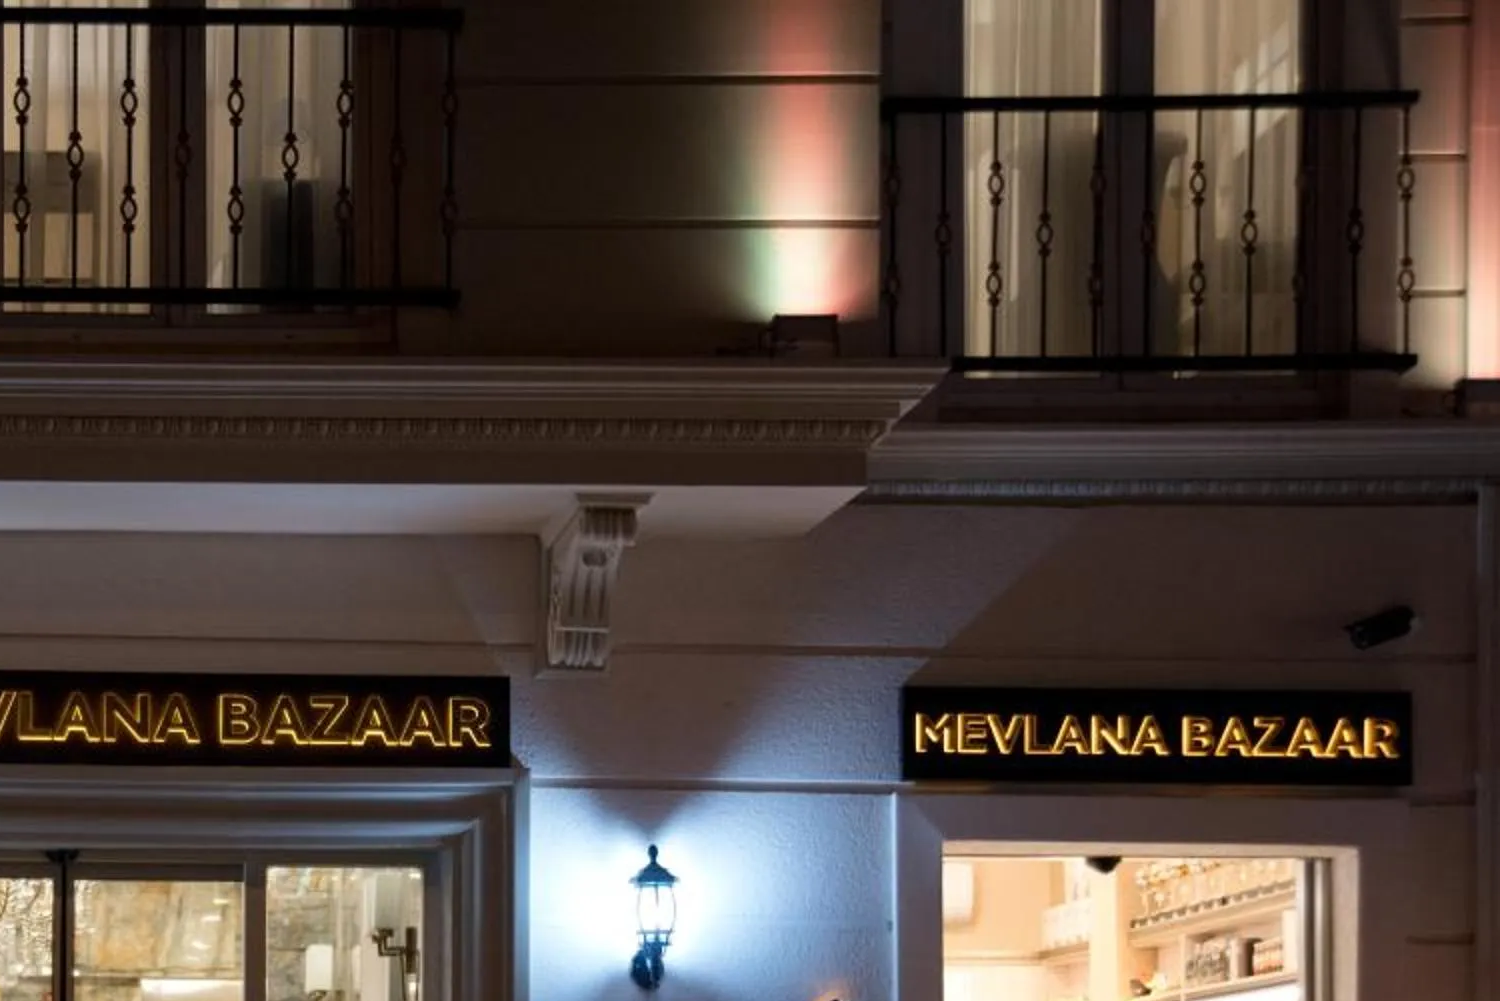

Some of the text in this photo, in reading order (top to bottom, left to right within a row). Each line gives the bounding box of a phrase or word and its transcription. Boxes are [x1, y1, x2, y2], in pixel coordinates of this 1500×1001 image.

[218, 694, 491, 747] BAZAAR
[915, 712, 1400, 759] MEVLANA BAZAAR
